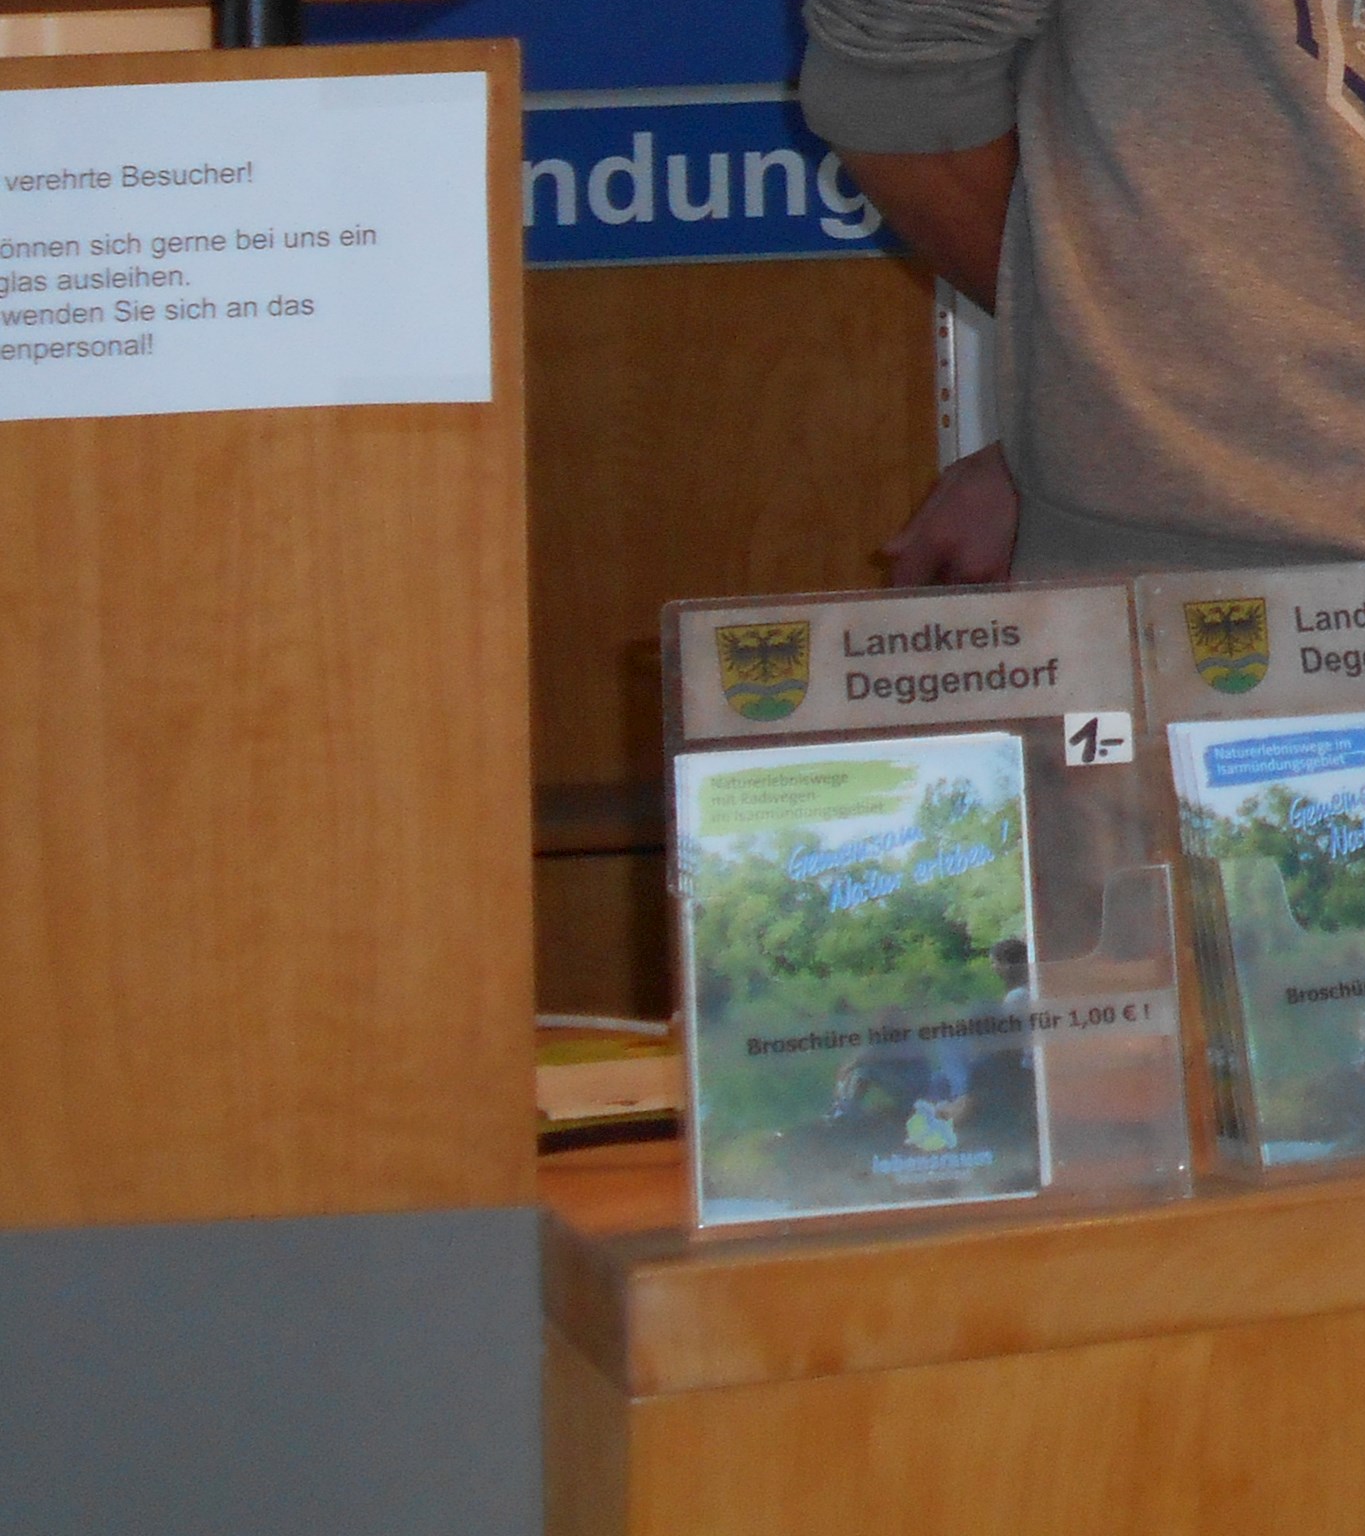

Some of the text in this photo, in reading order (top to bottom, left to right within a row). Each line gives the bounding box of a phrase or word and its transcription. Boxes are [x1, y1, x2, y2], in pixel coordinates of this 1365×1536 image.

[5, 161, 253, 192] verehrte Besucher!
[522, 131, 884, 240] ndung
[0, 224, 377, 260] önnen sich gerne bei uns ein
[57, 267, 191, 292] ausleihen.
[0, 295, 315, 327] wenden Sie sich an das
[0, 333, 153, 364] enpersonal!
[842, 620, 1022, 657] Landkreis
[845, 658, 1059, 704] Deggendorf
[1214, 738, 1353, 761] Naturerlebniswege im
[1216, 753, 1347, 777] Isarmündungsgebiet
[710, 773, 850, 790] Naturerlebniswege
[746, 1030, 861, 1056] Broschüre
[868, 1025, 912, 1045] hier
[918, 1015, 1022, 1041] erhältlich
[1029, 1011, 1062, 1032] für
[1067, 1006, 1116, 1031] 1,00
[1122, 1004, 1138, 1022] €
